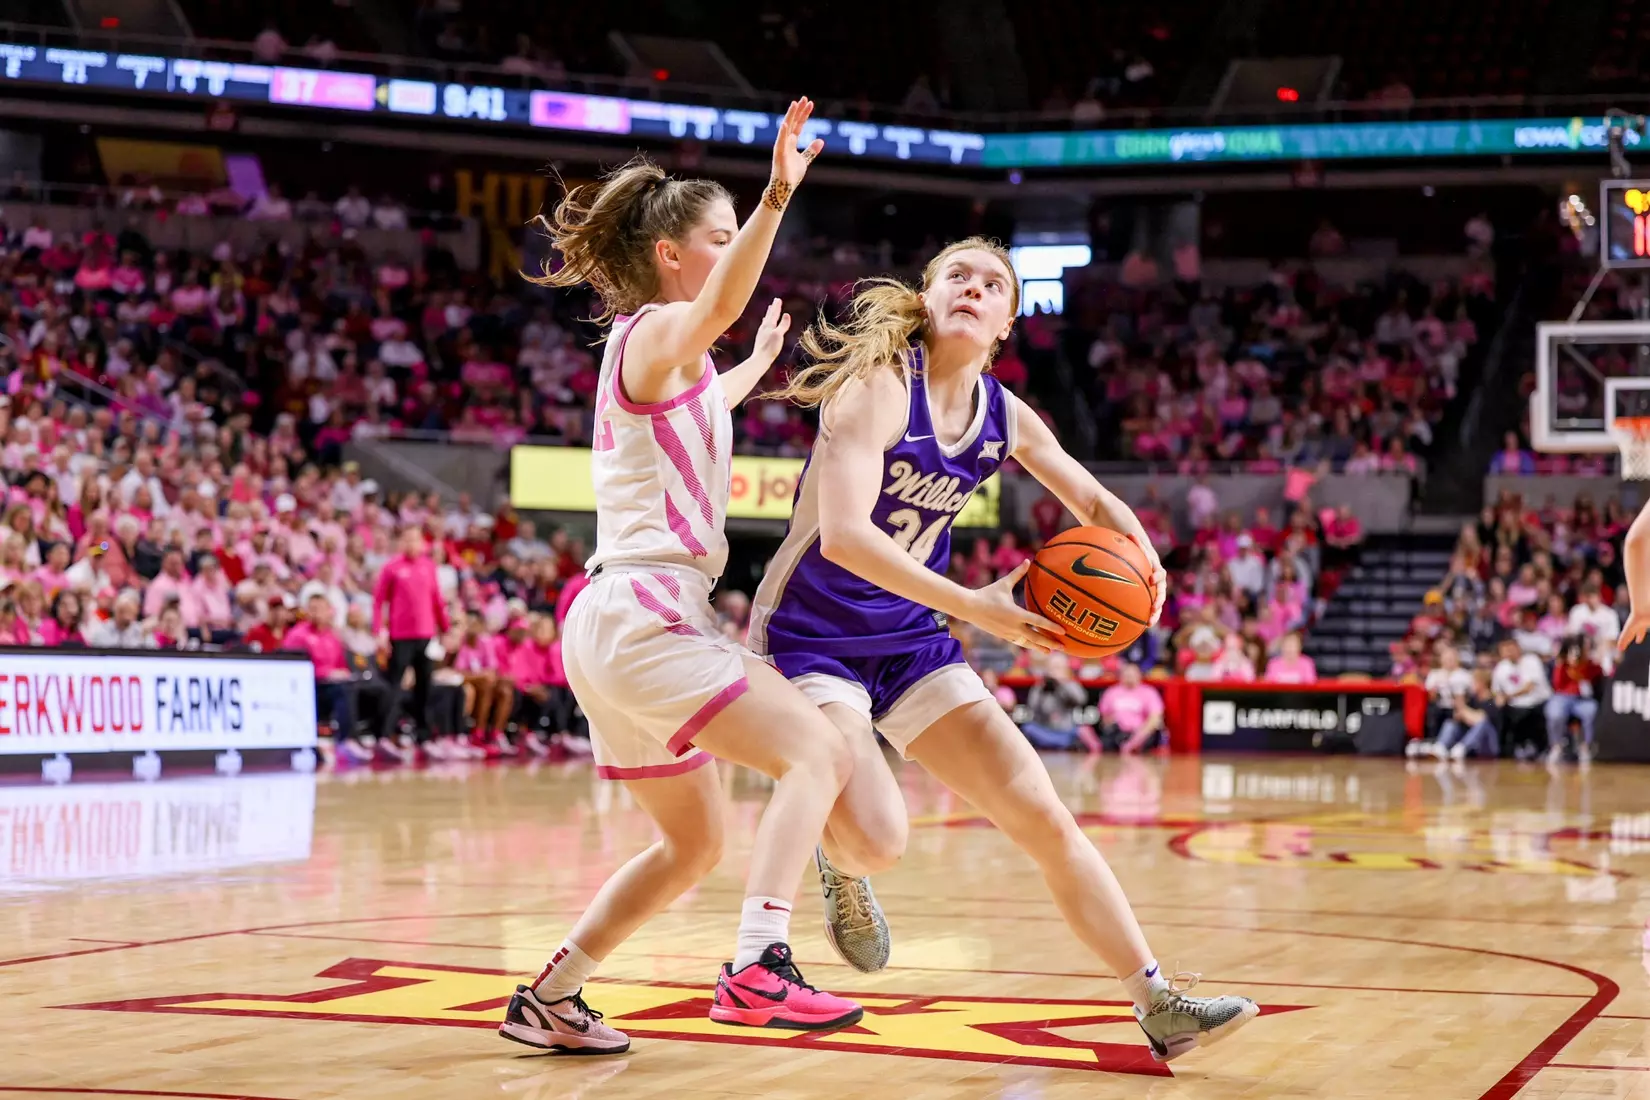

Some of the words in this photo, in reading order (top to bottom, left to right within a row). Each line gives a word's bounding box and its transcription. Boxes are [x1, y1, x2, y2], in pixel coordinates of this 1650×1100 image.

[1045, 604, 1110, 642] CHAMPIONSHIP
[1048, 588, 1120, 638] ELITE
[155, 676, 243, 732] FARMS
